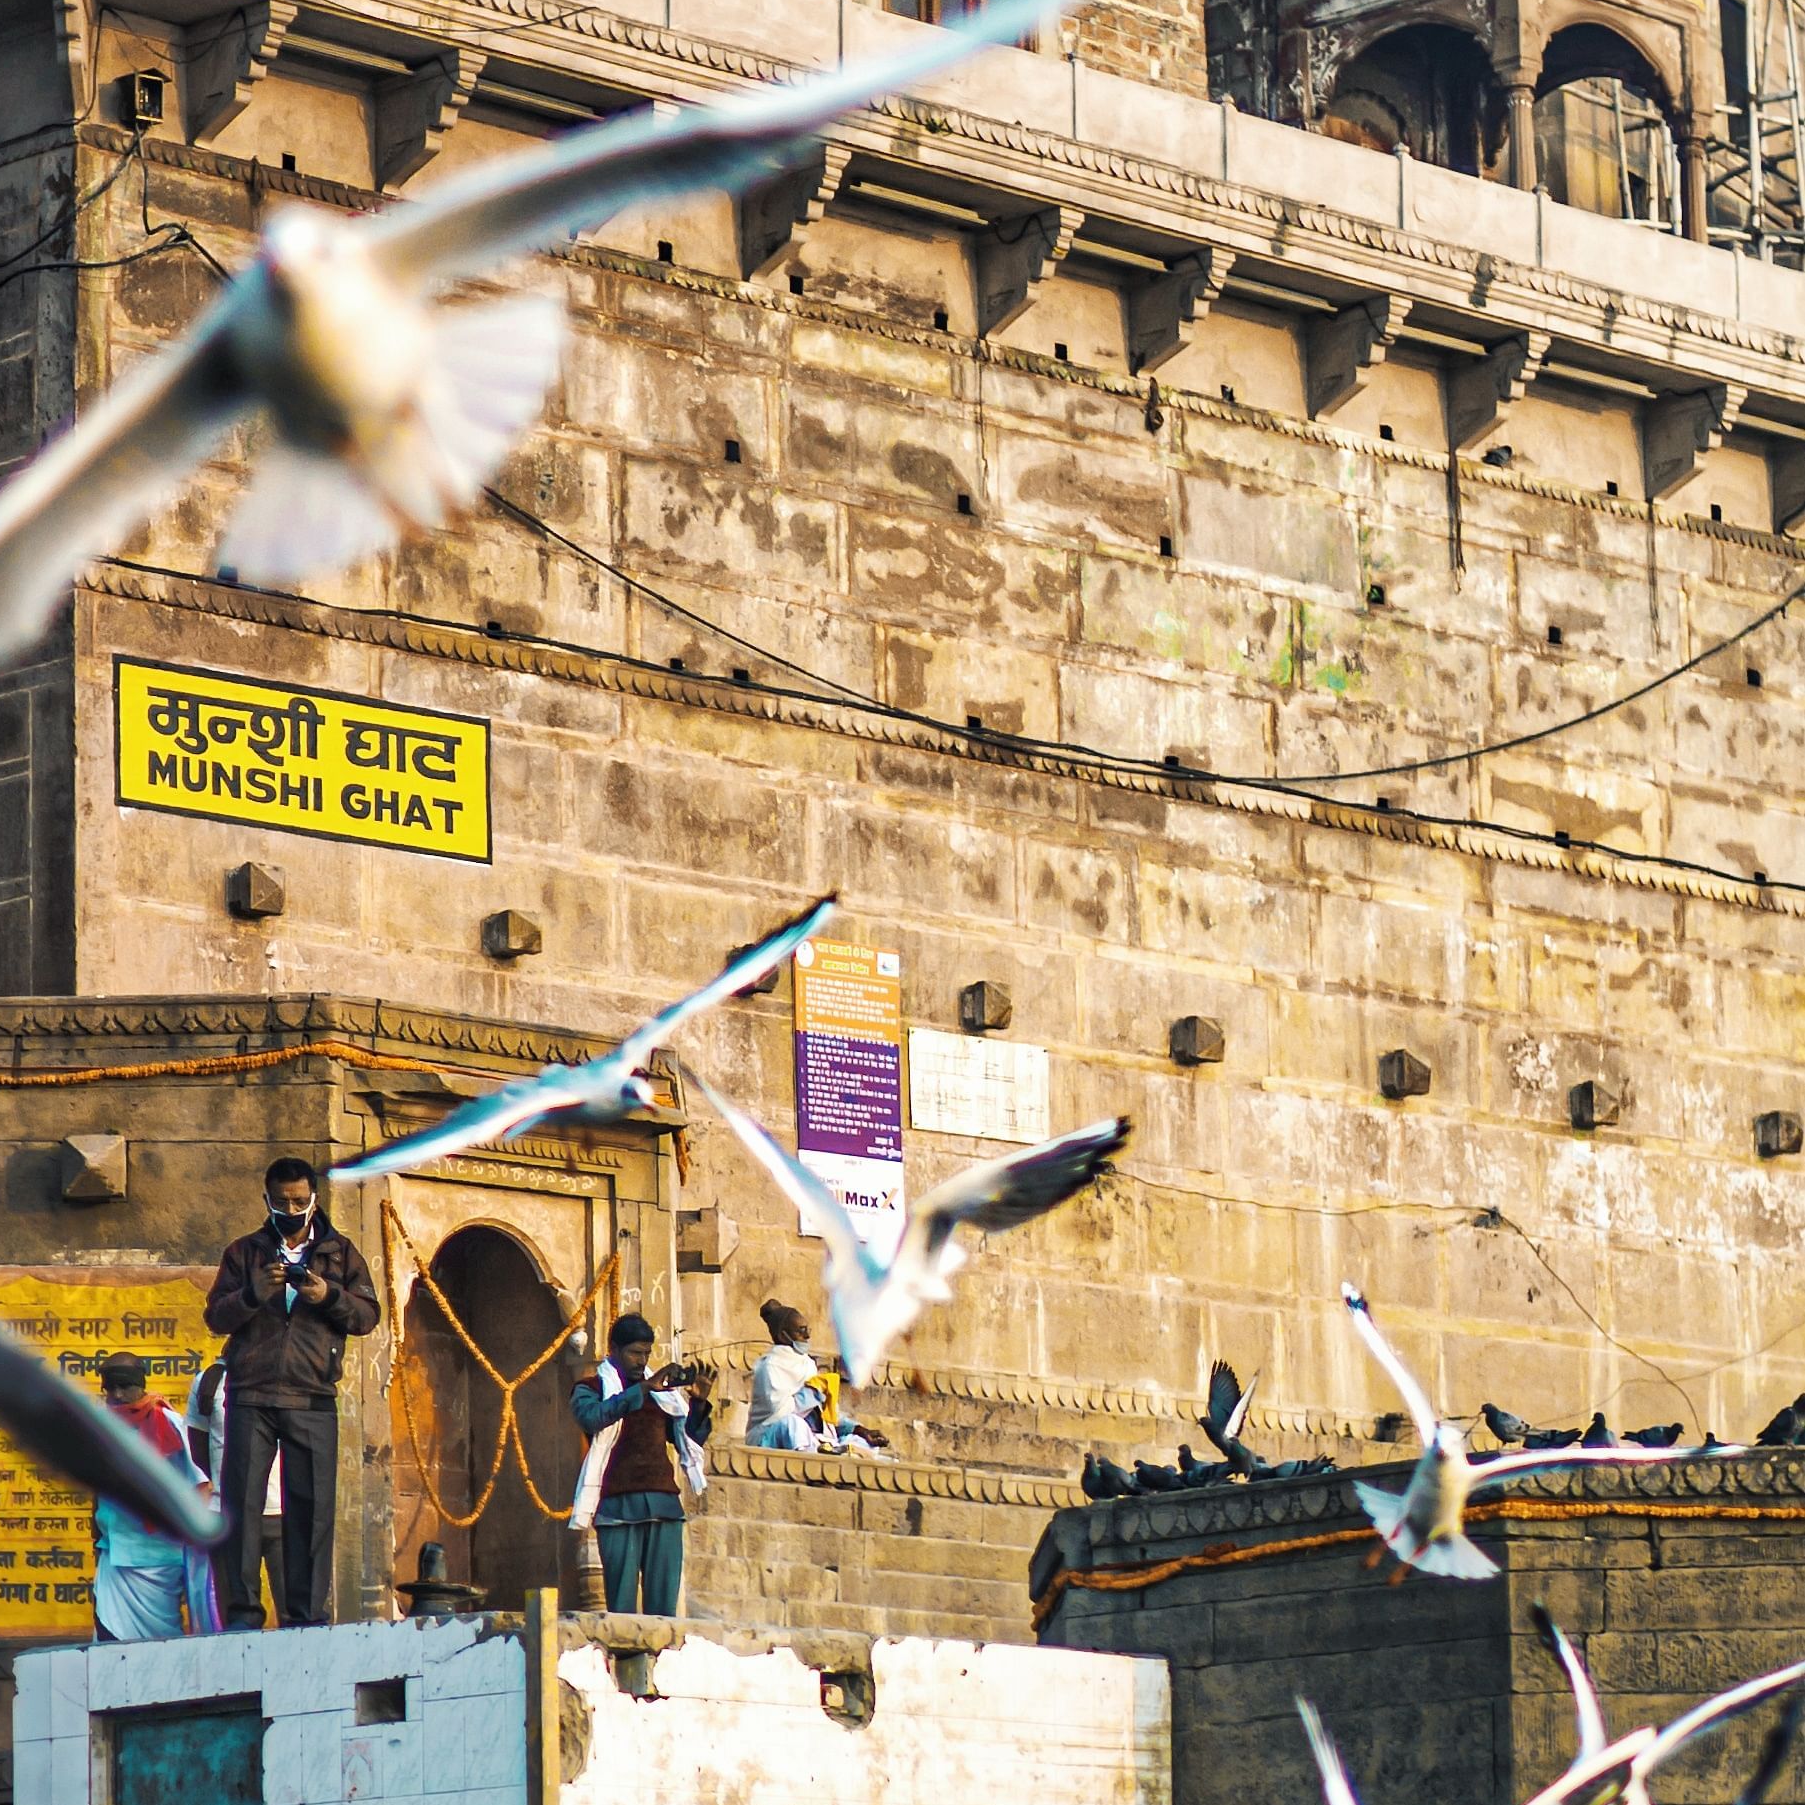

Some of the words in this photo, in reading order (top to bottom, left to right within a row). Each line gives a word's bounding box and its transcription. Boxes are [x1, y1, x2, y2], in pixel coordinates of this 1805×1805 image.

[147, 686, 325, 767] मुन्शी
[343, 719, 462, 783] घाट
[148, 750, 324, 812] MUNSHI
[341, 784, 464, 835] GHAT
[68, 1316, 116, 1342] नगर
